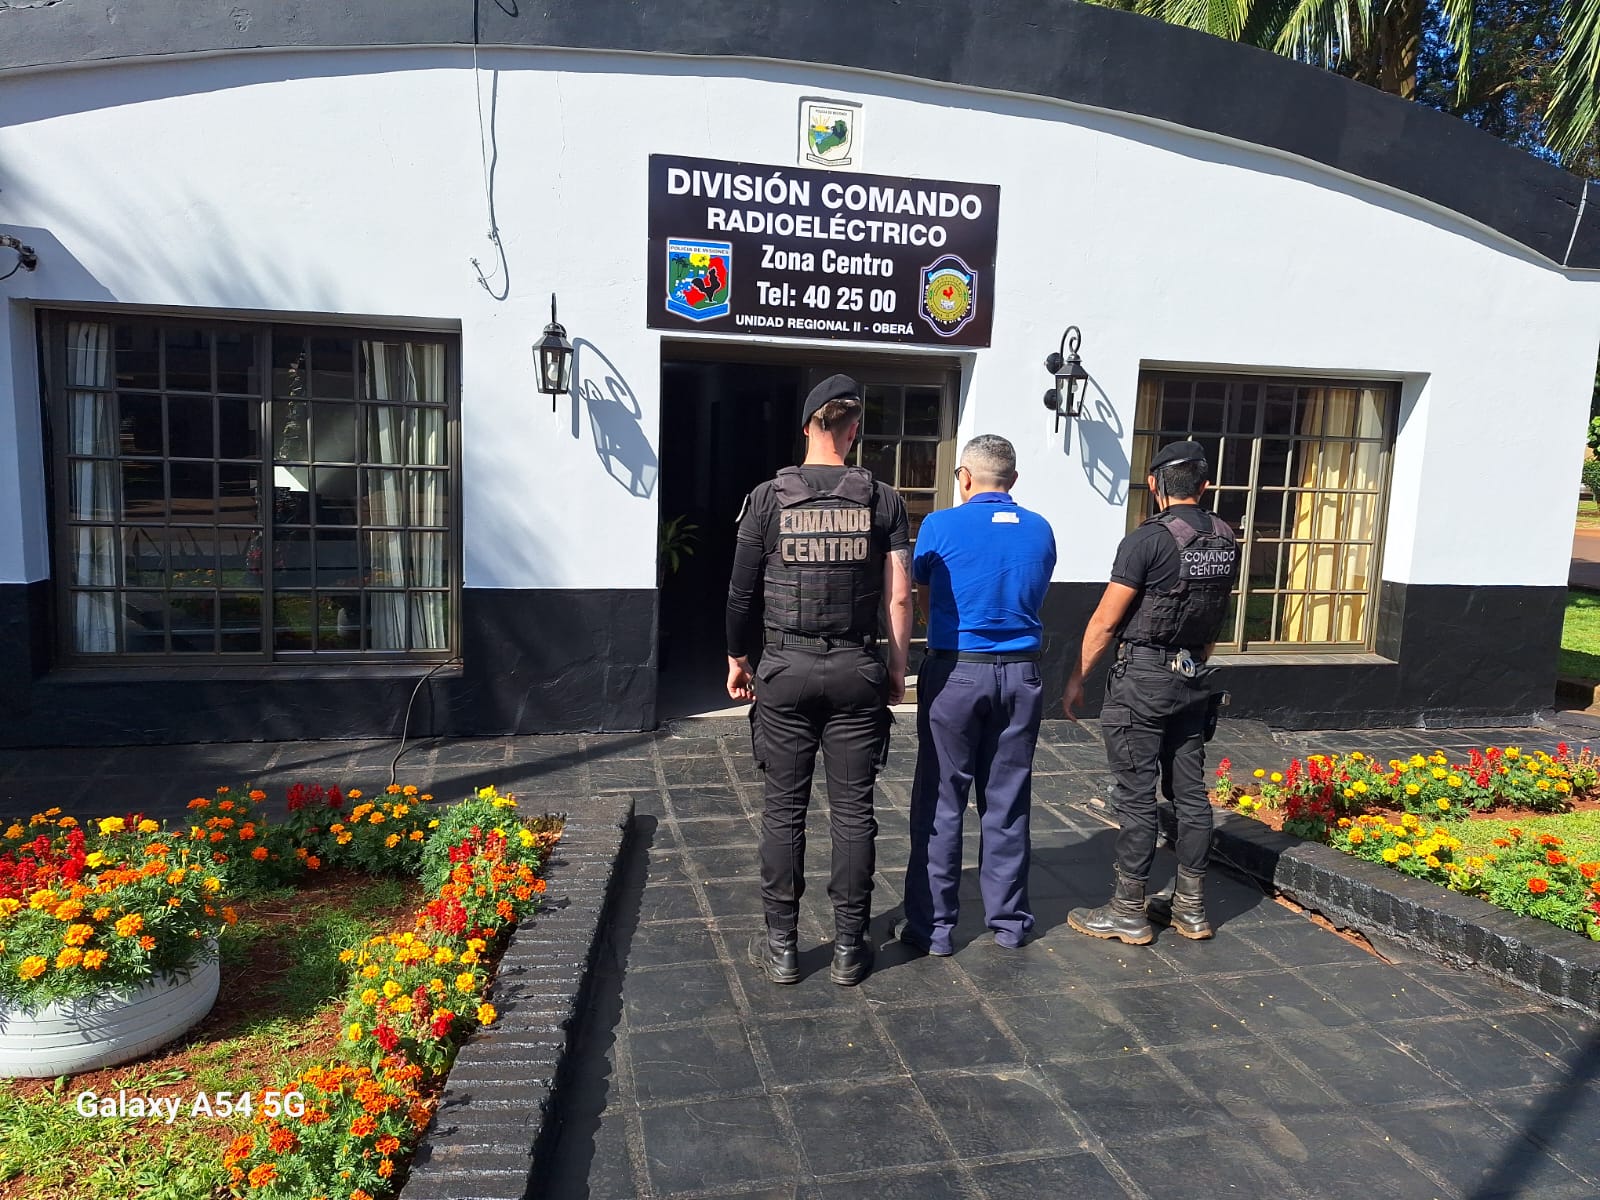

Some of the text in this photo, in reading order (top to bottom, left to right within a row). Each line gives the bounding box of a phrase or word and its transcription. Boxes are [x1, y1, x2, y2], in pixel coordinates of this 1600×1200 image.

[667, 168, 982, 220] DIVISIÓN COMANDO
[707, 207, 947, 247] RADIOELÉCTRICO
[761, 245, 894, 277] Zona Centro
[756, 281, 897, 313] Tel: 40 25 00
[735, 315, 784, 328] UNIDAD
[787, 318, 850, 331] REGIONAL
[853, 322, 861, 332] II
[872, 321, 914, 335] OBERÁ
[780, 509, 870, 533] COMANDO
[781, 537, 867, 561] CENTRO
[1184, 551, 1235, 562] COMANDO
[1189, 564, 1231, 576] CENTRO
